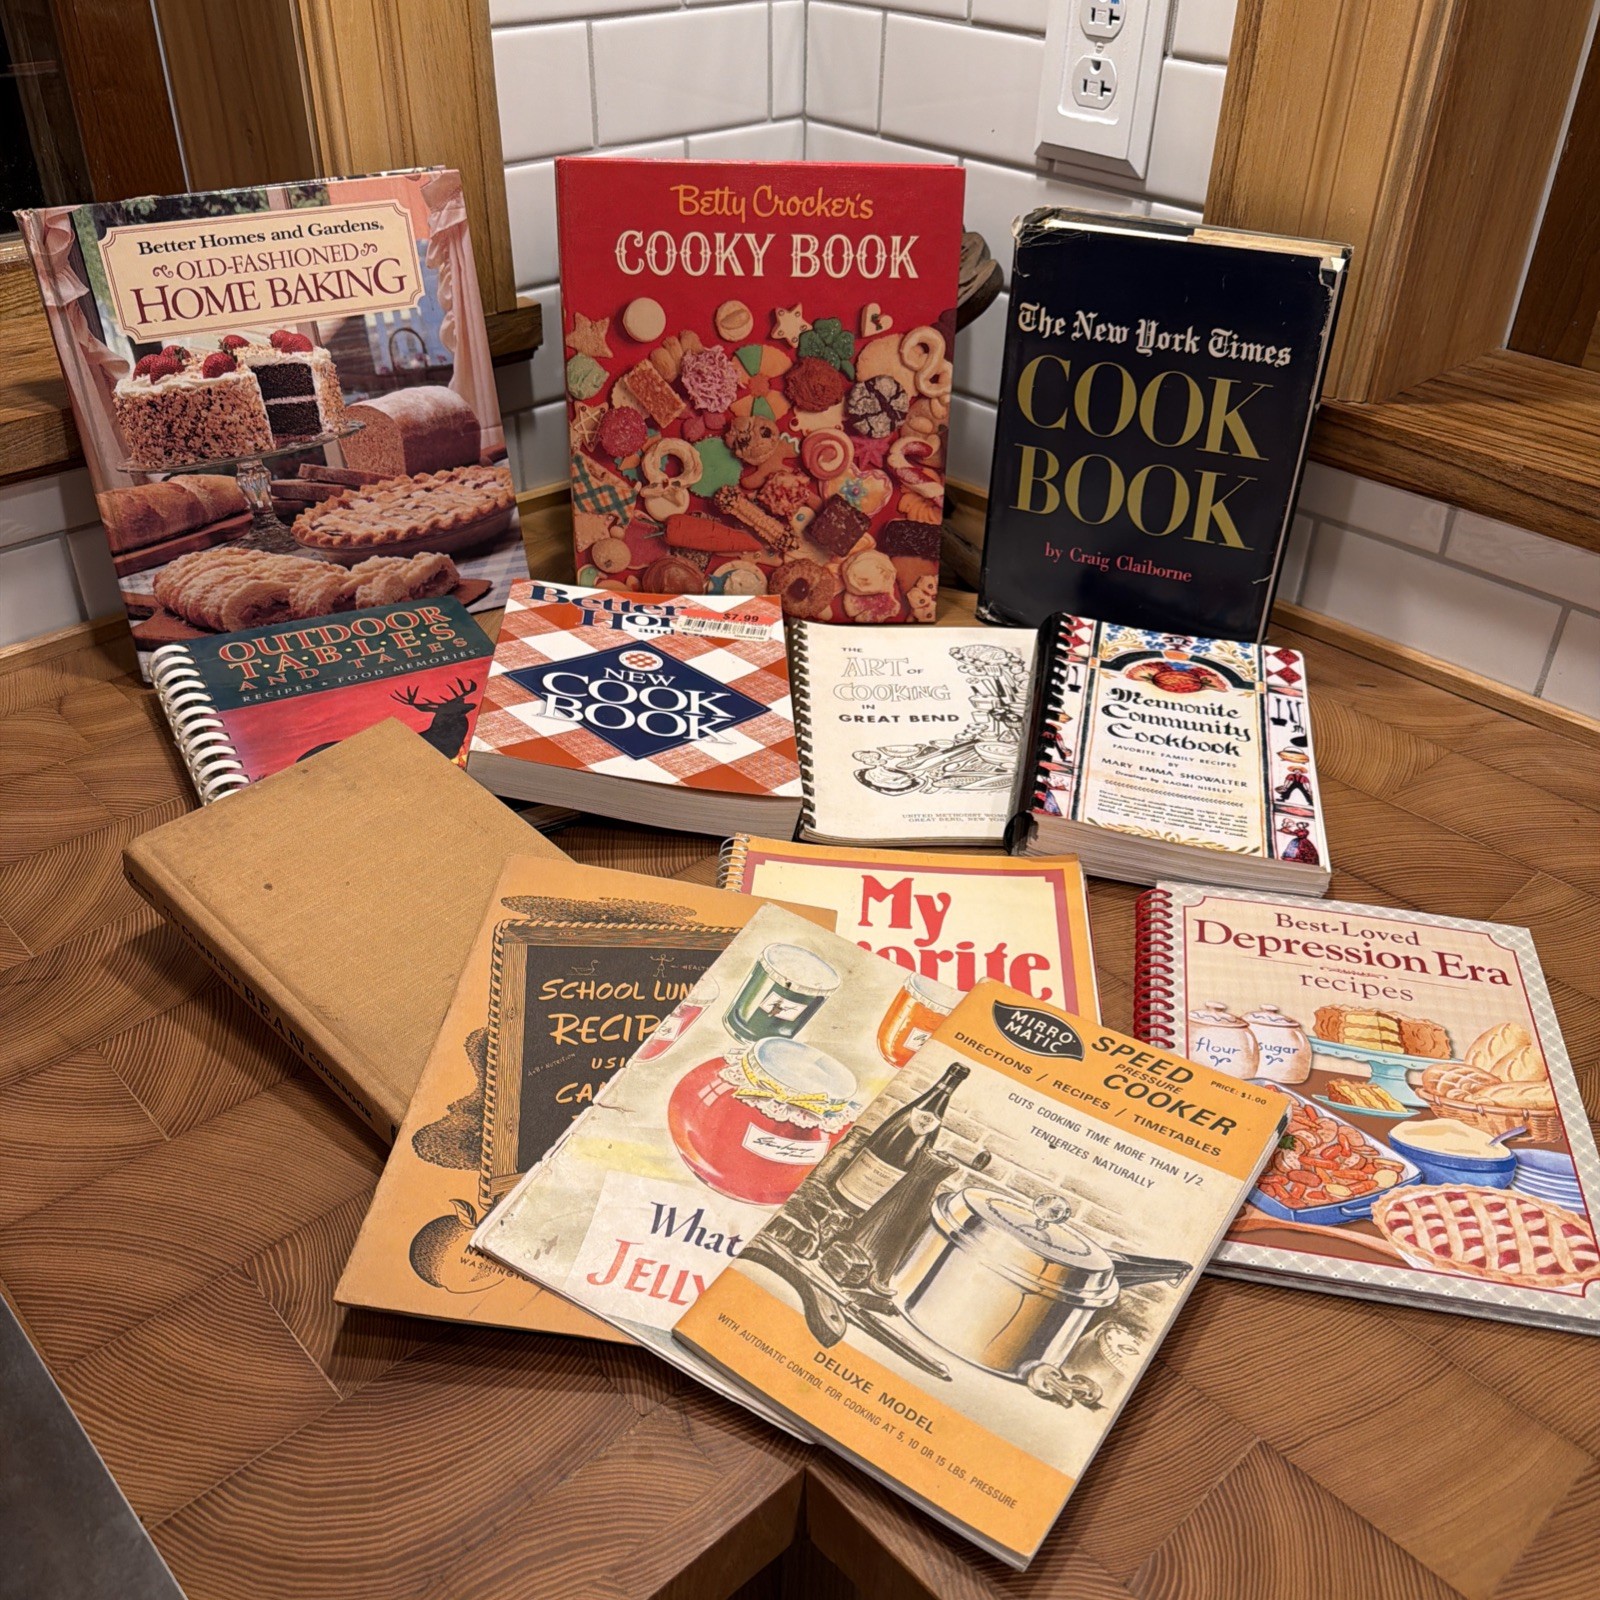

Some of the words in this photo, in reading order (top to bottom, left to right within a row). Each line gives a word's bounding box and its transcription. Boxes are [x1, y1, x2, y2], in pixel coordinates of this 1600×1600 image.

[670, 184, 746, 223] Betty
[753, 185, 874, 220] Crocker's
[137, 237, 196, 255] Better
[199, 231, 265, 249] Homes
[271, 225, 304, 240] and
[614, 229, 776, 278] COOKY
[790, 233, 920, 279] BOOK
[176, 242, 360, 281] OLD-FASHIONED
[130, 281, 260, 325] HOME
[265, 258, 407, 308] BAKING
[1018, 302, 1066, 338] The
[1071, 310, 1130, 344] New
[1135, 318, 1201, 356] York
[1208, 328, 1292, 367] Times
[1017, 354, 1274, 461] COOK
[1009, 443, 1258, 551] BOOK
[1045, 542, 1063, 563] by
[1069, 547, 1110, 572] Craig
[1116, 555, 1193, 583] Claiborne
[530, 584, 688, 617] Better
[723, 613, 759, 622] $7.99
[219, 606, 452, 662] OUTDOOR
[638, 627, 676, 636] and
[239, 668, 320, 692] AND
[348, 637, 468, 669] TALES
[243, 683, 313, 703] RECIPES
[338, 669, 384, 684] FOOD
[393, 650, 477, 672] MEMORIES
[603, 668, 676, 687] NEW
[841, 657, 909, 678] ART
[542, 672, 735, 718] COOK
[833, 682, 951, 702] COOKING
[1106, 688, 1241, 719] Mennonite
[535, 693, 737, 744] BOOK
[838, 714, 901, 724] GREAT
[909, 714, 959, 723] BEND
[1101, 703, 1252, 742] Community
[1107, 723, 1242, 758] Cookbook
[1112, 744, 1155, 756] FAVORITE
[1160, 753, 1194, 762] FAMILY
[1199, 759, 1237, 768] RECIPES
[1101, 758, 1133, 769] MARY
[1139, 765, 1174, 776] EMMA
[1180, 773, 1248, 787] SHOWALTER
[858, 875, 952, 947] My
[1275, 913, 1420, 947] Best-Loved
[857, 941, 1053, 1001] orite
[1193, 918, 1431, 976] Depression
[1431, 950, 1513, 986] Era
[538, 978, 646, 1002] SCHOOL
[653, 980, 694, 1002] LUN
[1299, 972, 1415, 1002] recipes
[244, 985, 306, 1054] BEAN
[547, 1012, 662, 1046] RECIP
[1004, 1022, 1063, 1054] MATIC
[591, 1057, 626, 1070] USI
[1091, 1035, 1194, 1084] SPEED
[1195, 1037, 1241, 1055] flour
[1258, 1041, 1299, 1056] sugar
[953, 1031, 1033, 1075] DIRECTIONS
[1052, 1079, 1111, 1111] RECIPES
[1134, 1113, 1222, 1157] TIMETABLES
[1115, 1063, 1183, 1095] PRESSURE
[1210, 1080, 1240, 1096] PRICE:
[1240, 1091, 1267, 1106] $1.00
[1102, 1074, 1238, 1136] COOKER
[1008, 1092, 1033, 1110] CUTS
[1037, 1105, 1081, 1133] COOKING
[1085, 1126, 1111, 1148] TIME
[1113, 1140, 1145, 1163] MORE
[1150, 1155, 1180, 1177] THAN
[1182, 1171, 1204, 1188] 1/2
[1030, 1124, 1090, 1161] TENDERIZES
[1093, 1155, 1156, 1189] NATURALLY
[650, 1201, 743, 1257] What
[717, 1312, 741, 1333] WITH
[738, 1323, 787, 1365] AUTOMATIC
[786, 1359, 824, 1390] CONTROL
[824, 1386, 842, 1402] FOR
[842, 1397, 882, 1426] COOKING
[882, 1422, 896, 1434] AT
[896, 1430, 905, 1443] 5,
[907, 1437, 920, 1450] 10
[920, 1444, 935, 1459] OR
[935, 1453, 947, 1467] 15
[947, 1461, 967, 1480] LBS.
[969, 1476, 1019, 1509] PRESSURE
[812, 1351, 875, 1395] DELUXE
[877, 1391, 935, 1435] MODEL
